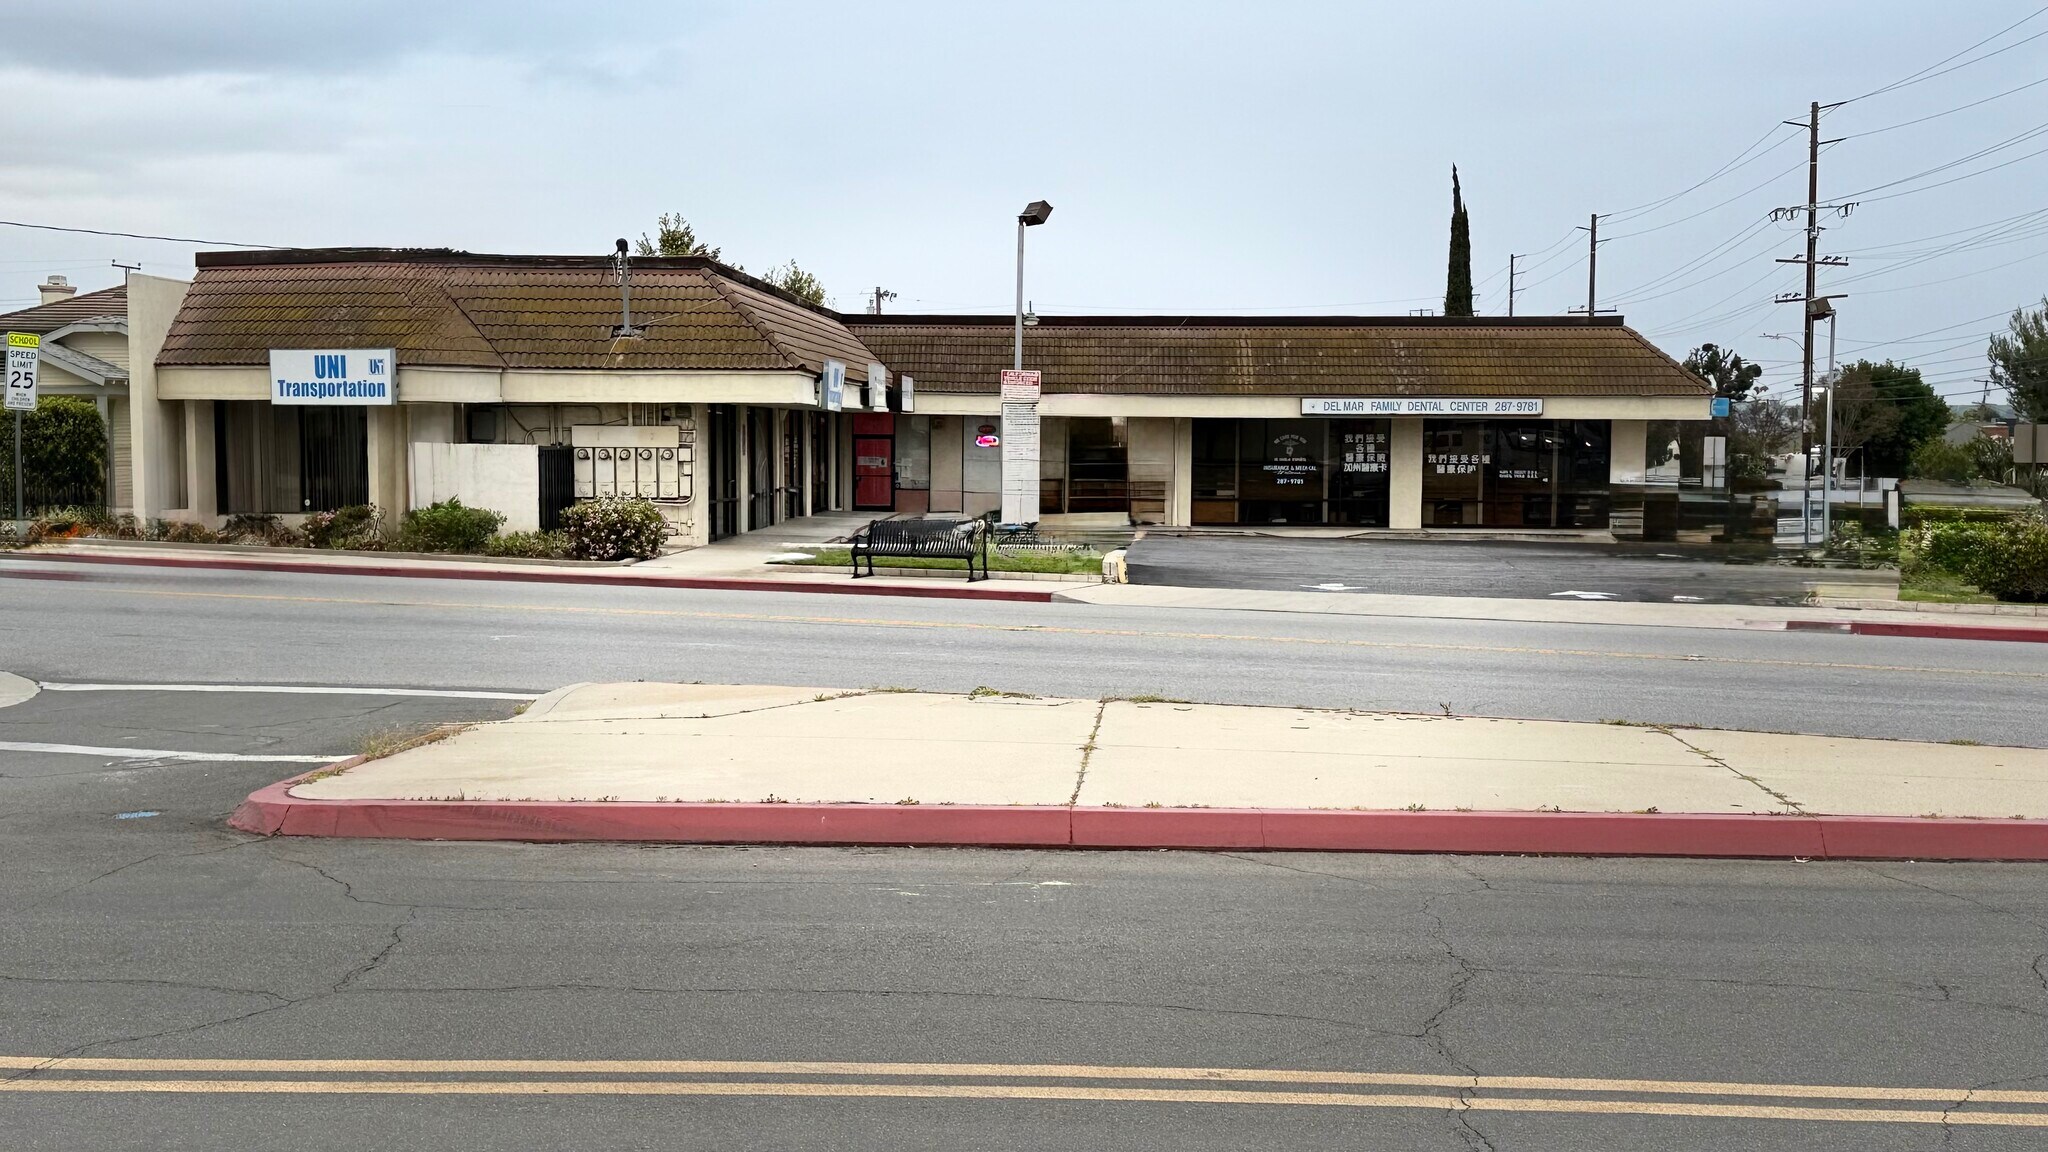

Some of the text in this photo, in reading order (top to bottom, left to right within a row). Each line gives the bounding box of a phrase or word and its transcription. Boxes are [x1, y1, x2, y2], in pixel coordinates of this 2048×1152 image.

[9, 335, 38, 345] SCHOOL
[10, 350, 37, 359] SPEED
[12, 360, 33, 369] LIMIT
[314, 354, 347, 379] UNI
[10, 370, 34, 389] 25
[277, 379, 386, 399] Transportation
[1370, 401, 1402, 411] FAMILY
[1407, 401, 1444, 411] DENTAL
[1449, 401, 1488, 411] CENTER
[1494, 401, 1538, 411] 287-9781
